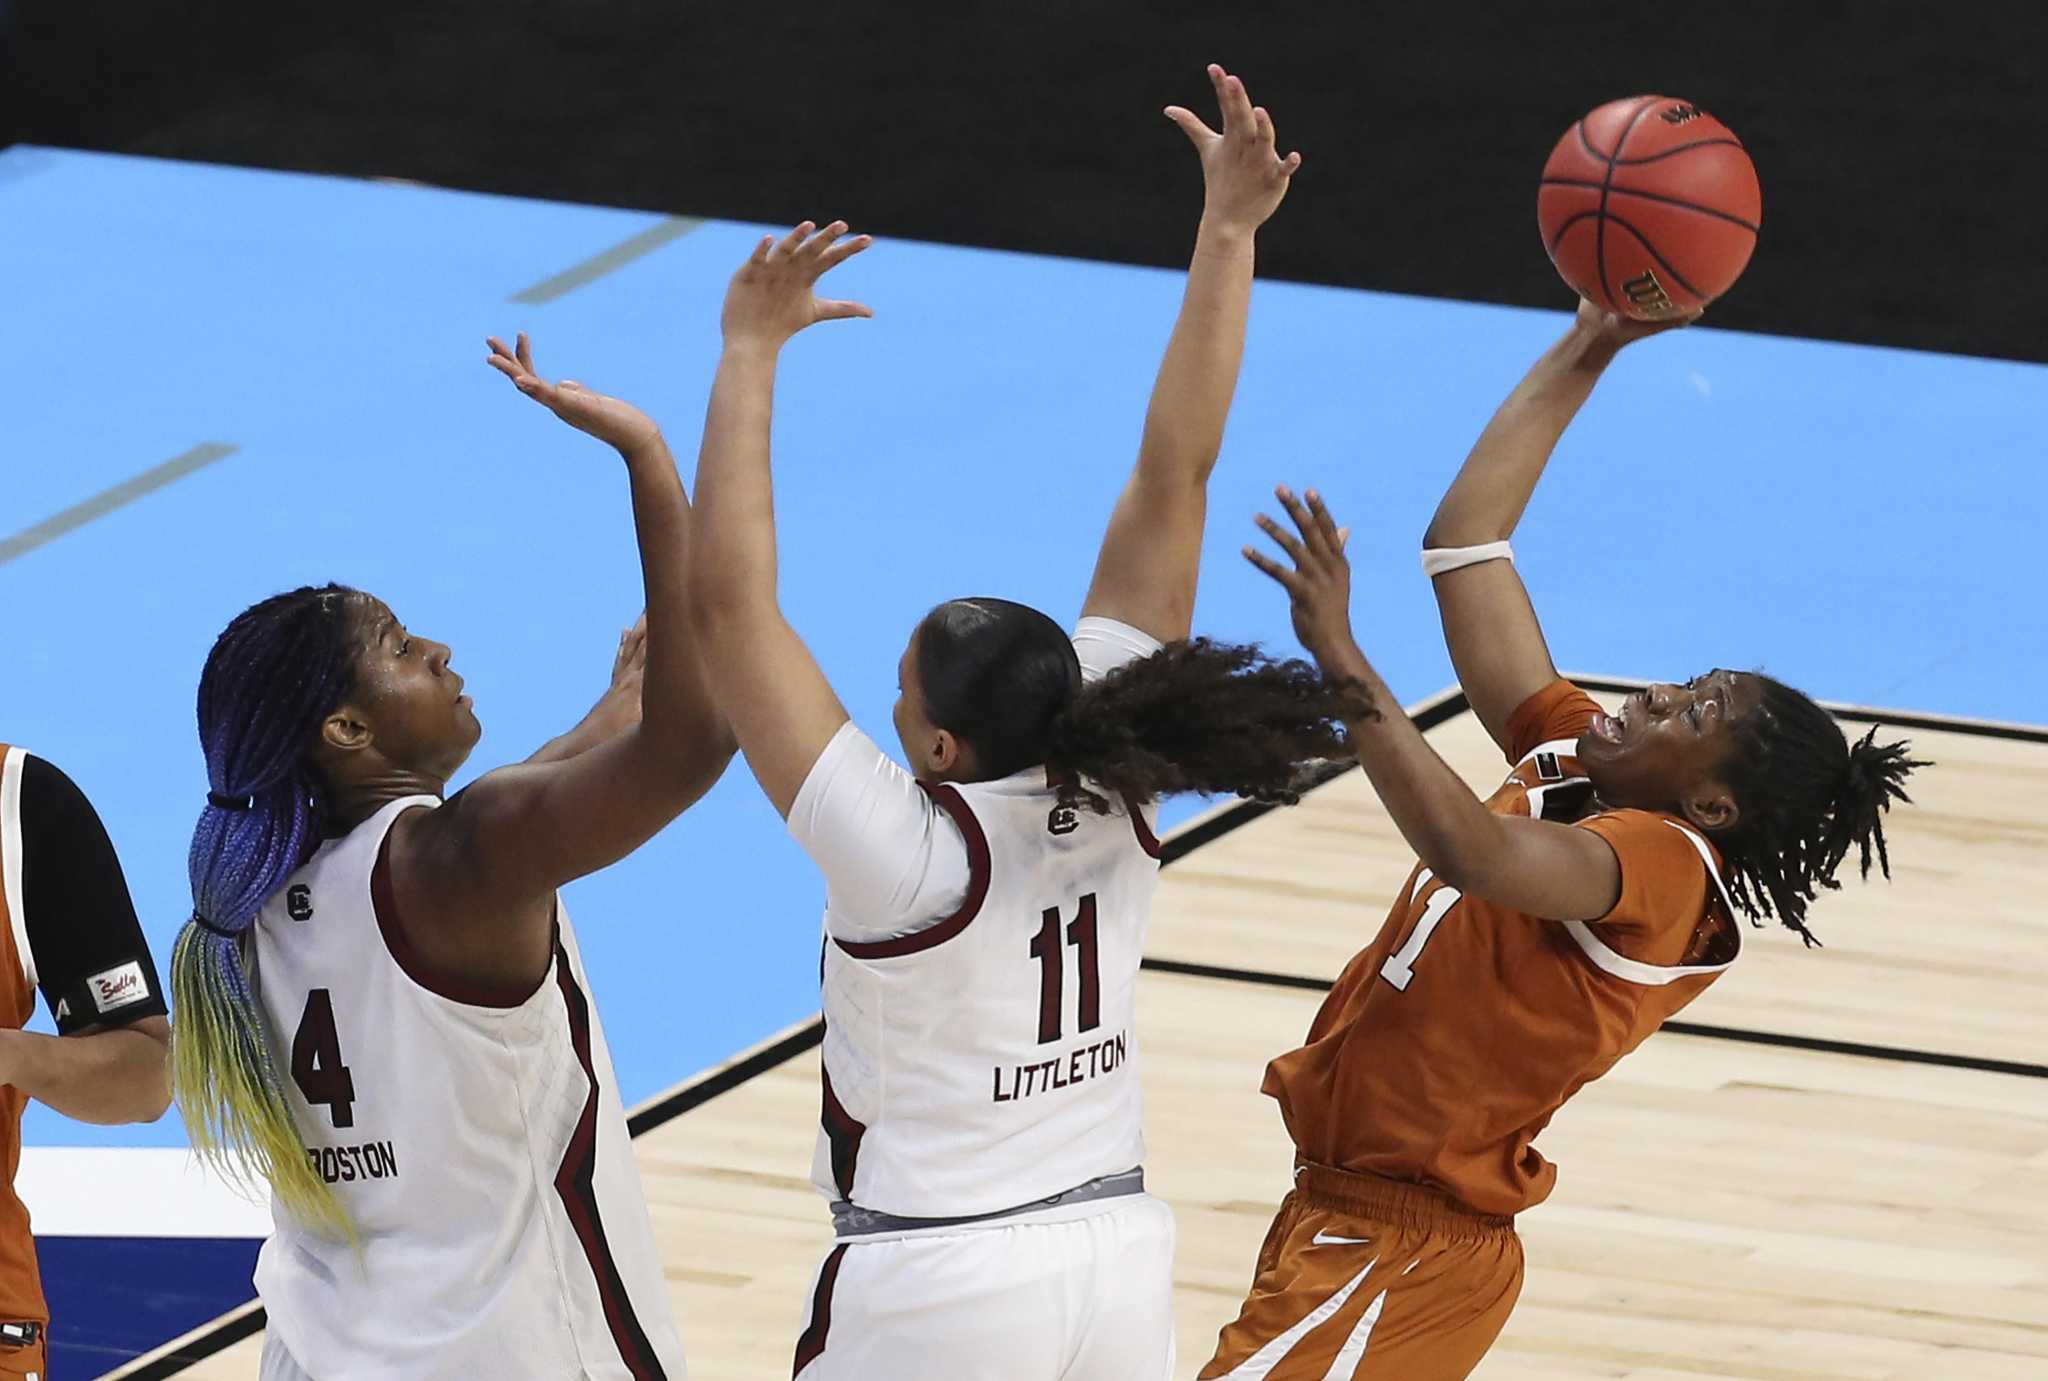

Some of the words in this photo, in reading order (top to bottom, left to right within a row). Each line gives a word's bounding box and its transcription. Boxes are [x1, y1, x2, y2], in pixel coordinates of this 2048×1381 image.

[1029, 891, 1100, 1045] 11
[290, 988, 356, 1128] 4
[993, 1029, 1127, 1103] LITTLETON
